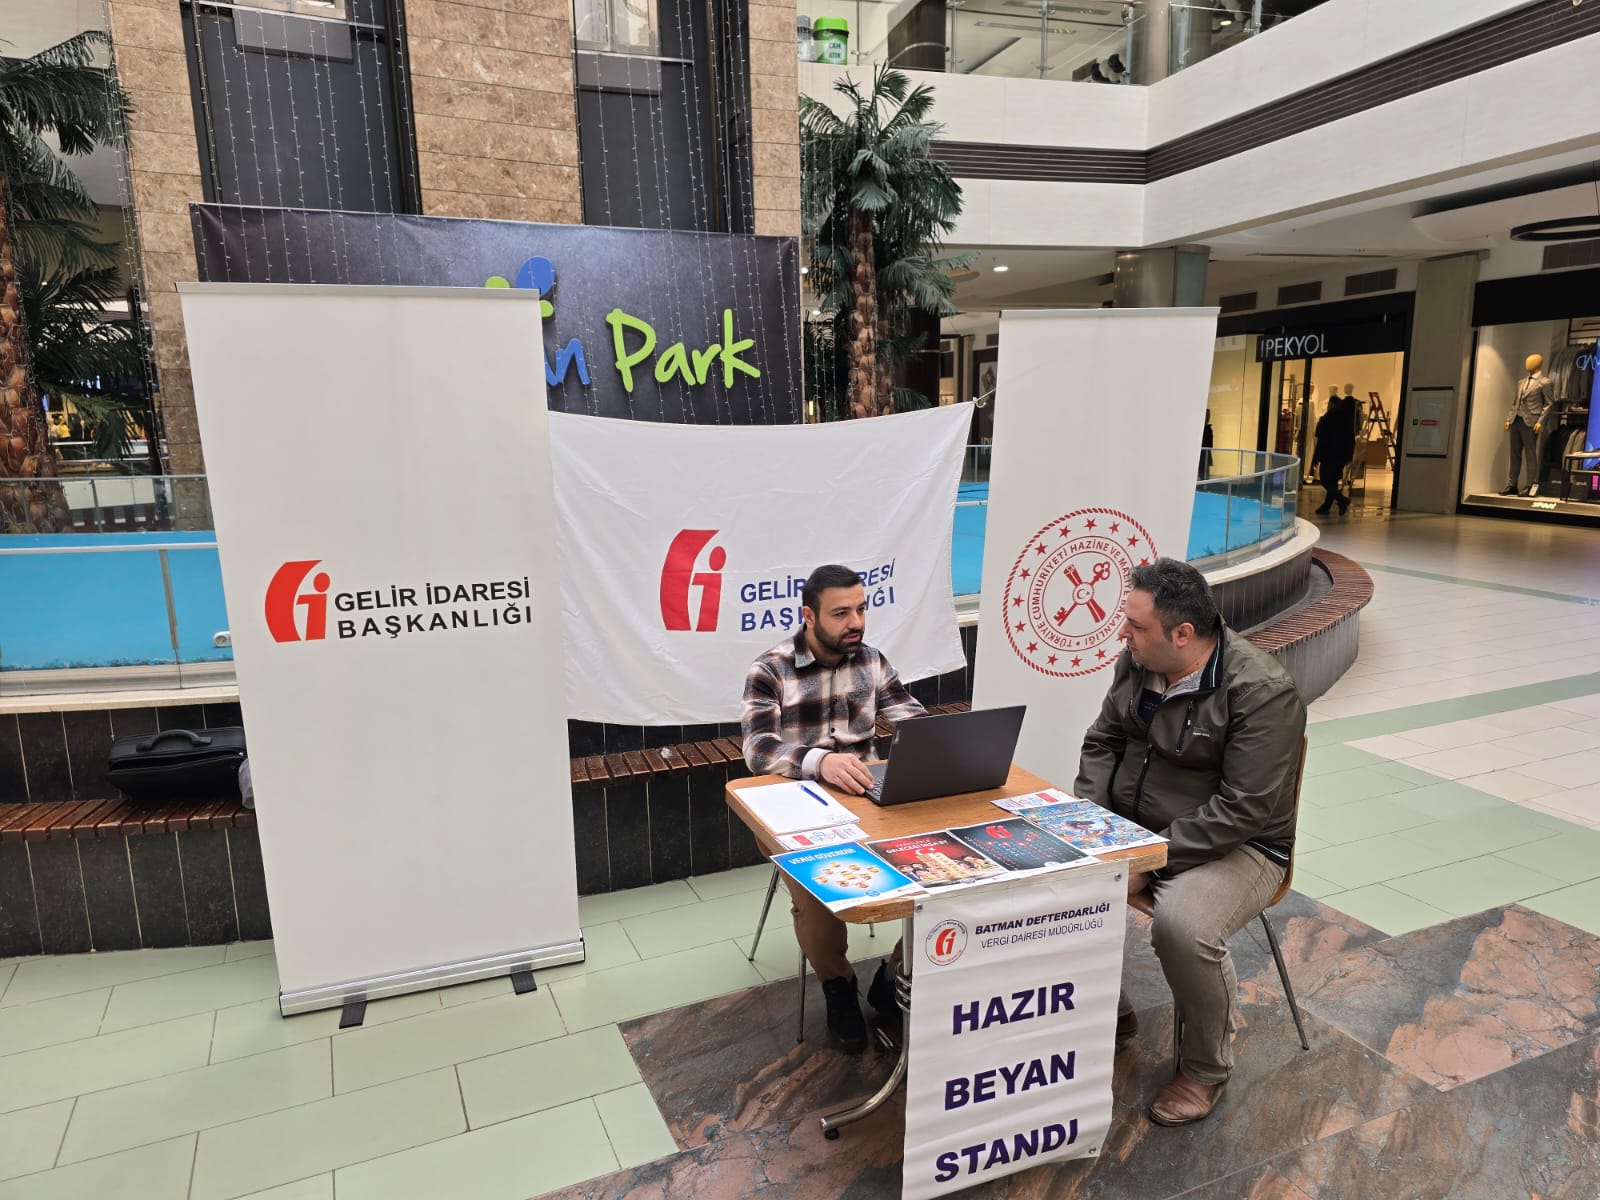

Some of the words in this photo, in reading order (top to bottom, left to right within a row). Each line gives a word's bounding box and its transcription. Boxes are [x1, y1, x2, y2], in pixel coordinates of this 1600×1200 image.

[605, 308, 761, 393] Park
[1070, 539, 1110, 553] HAZİNE
[1110, 546, 1121, 559] VE
[334, 585, 418, 612] GELİR
[425, 576, 530, 606] İDARESİ
[1032, 547, 1068, 620] CUMHURİYETİ
[338, 602, 532, 639] BAŞKANLIĞI
[1037, 621, 1073, 648] TÜRKİYE
[975, 918, 1023, 935] BATMAN
[1026, 902, 1110, 927] DEFTERDARLIĞI
[981, 934, 1009, 949] VERGİ
[1011, 927, 1046, 944] DAİRESİ
[1048, 918, 1103, 937] MÜDÜRLÜĞÜ
[952, 981, 1076, 1036] HAZIR
[945, 1050, 1076, 1111] BEYAN
[934, 1118, 1078, 1183] STANDI
